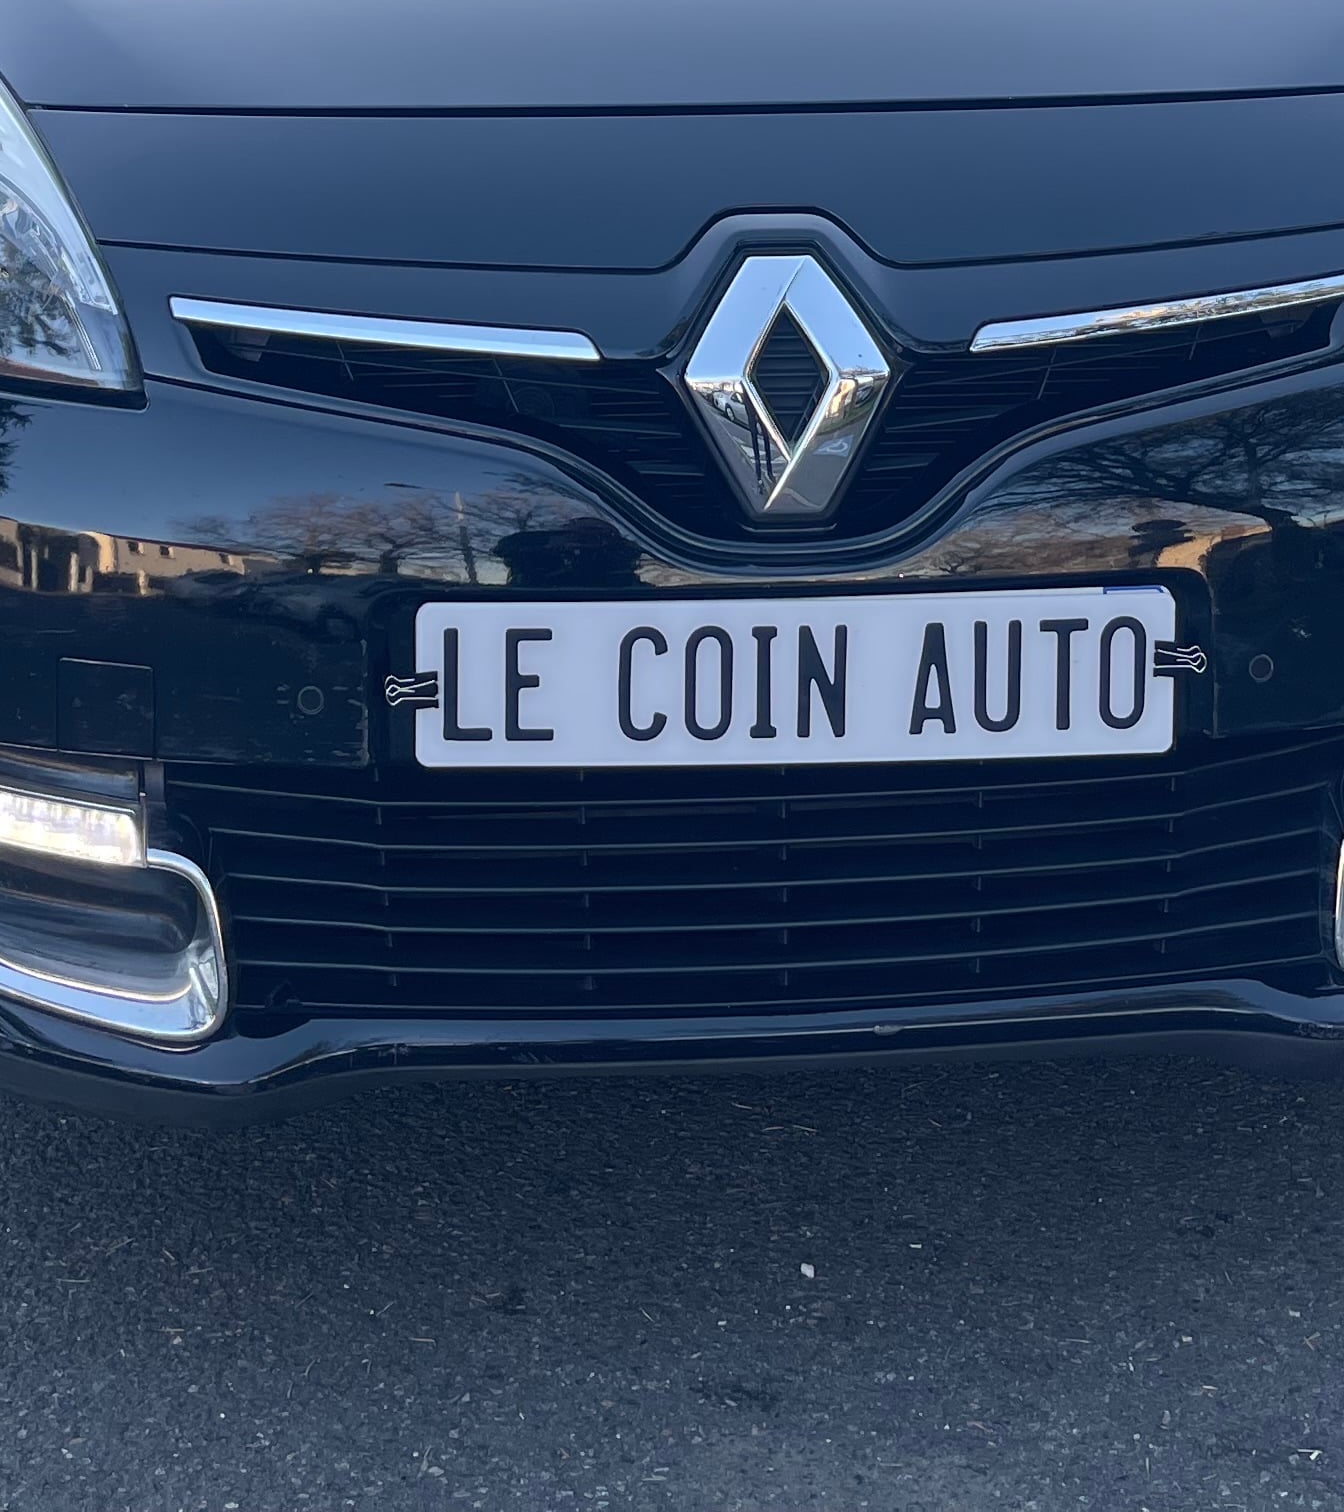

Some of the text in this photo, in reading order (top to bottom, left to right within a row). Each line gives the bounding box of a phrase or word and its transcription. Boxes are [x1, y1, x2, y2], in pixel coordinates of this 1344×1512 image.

[442, 615, 1147, 742] LE COIN AUTO
